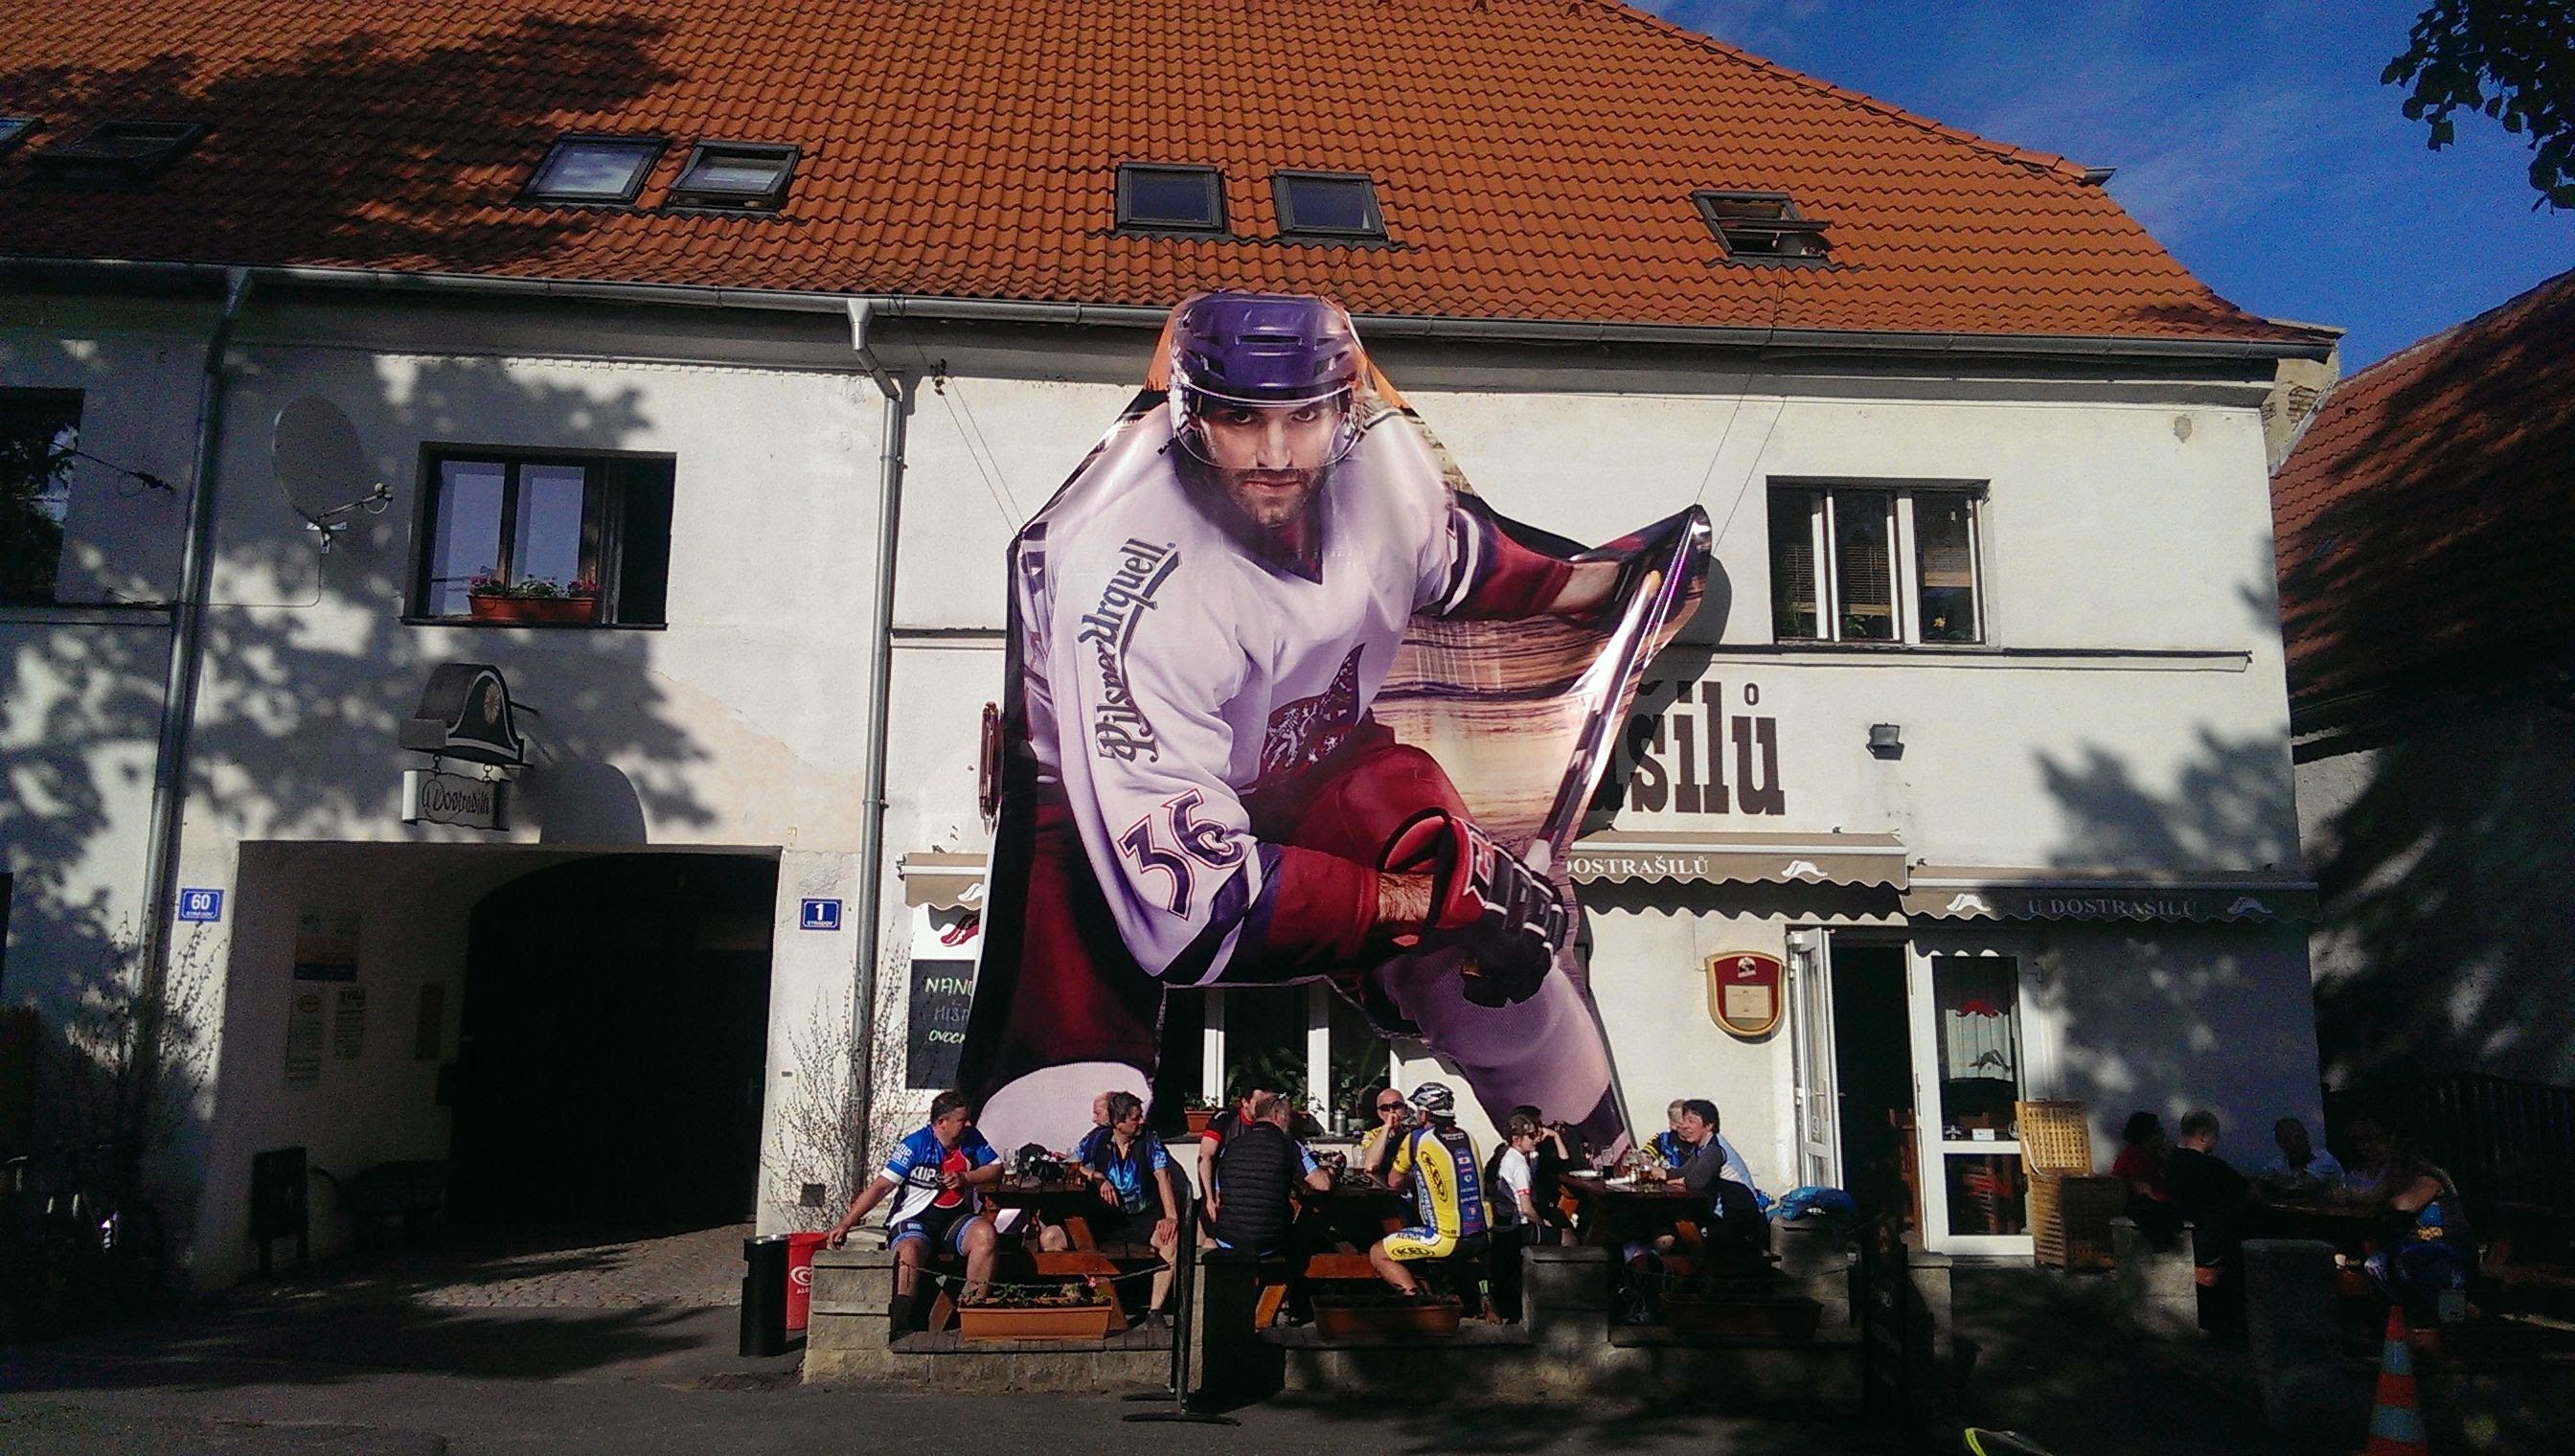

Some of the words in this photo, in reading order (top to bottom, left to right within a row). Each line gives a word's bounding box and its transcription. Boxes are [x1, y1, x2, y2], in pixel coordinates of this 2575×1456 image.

[1078, 538, 1169, 647] Urquell
[1095, 639, 1159, 762] Pilsner
[1116, 788, 1246, 921] 36
[192, 894, 211, 910] 60
[815, 903, 824, 921] 1
[2029, 899, 2041, 914] U
